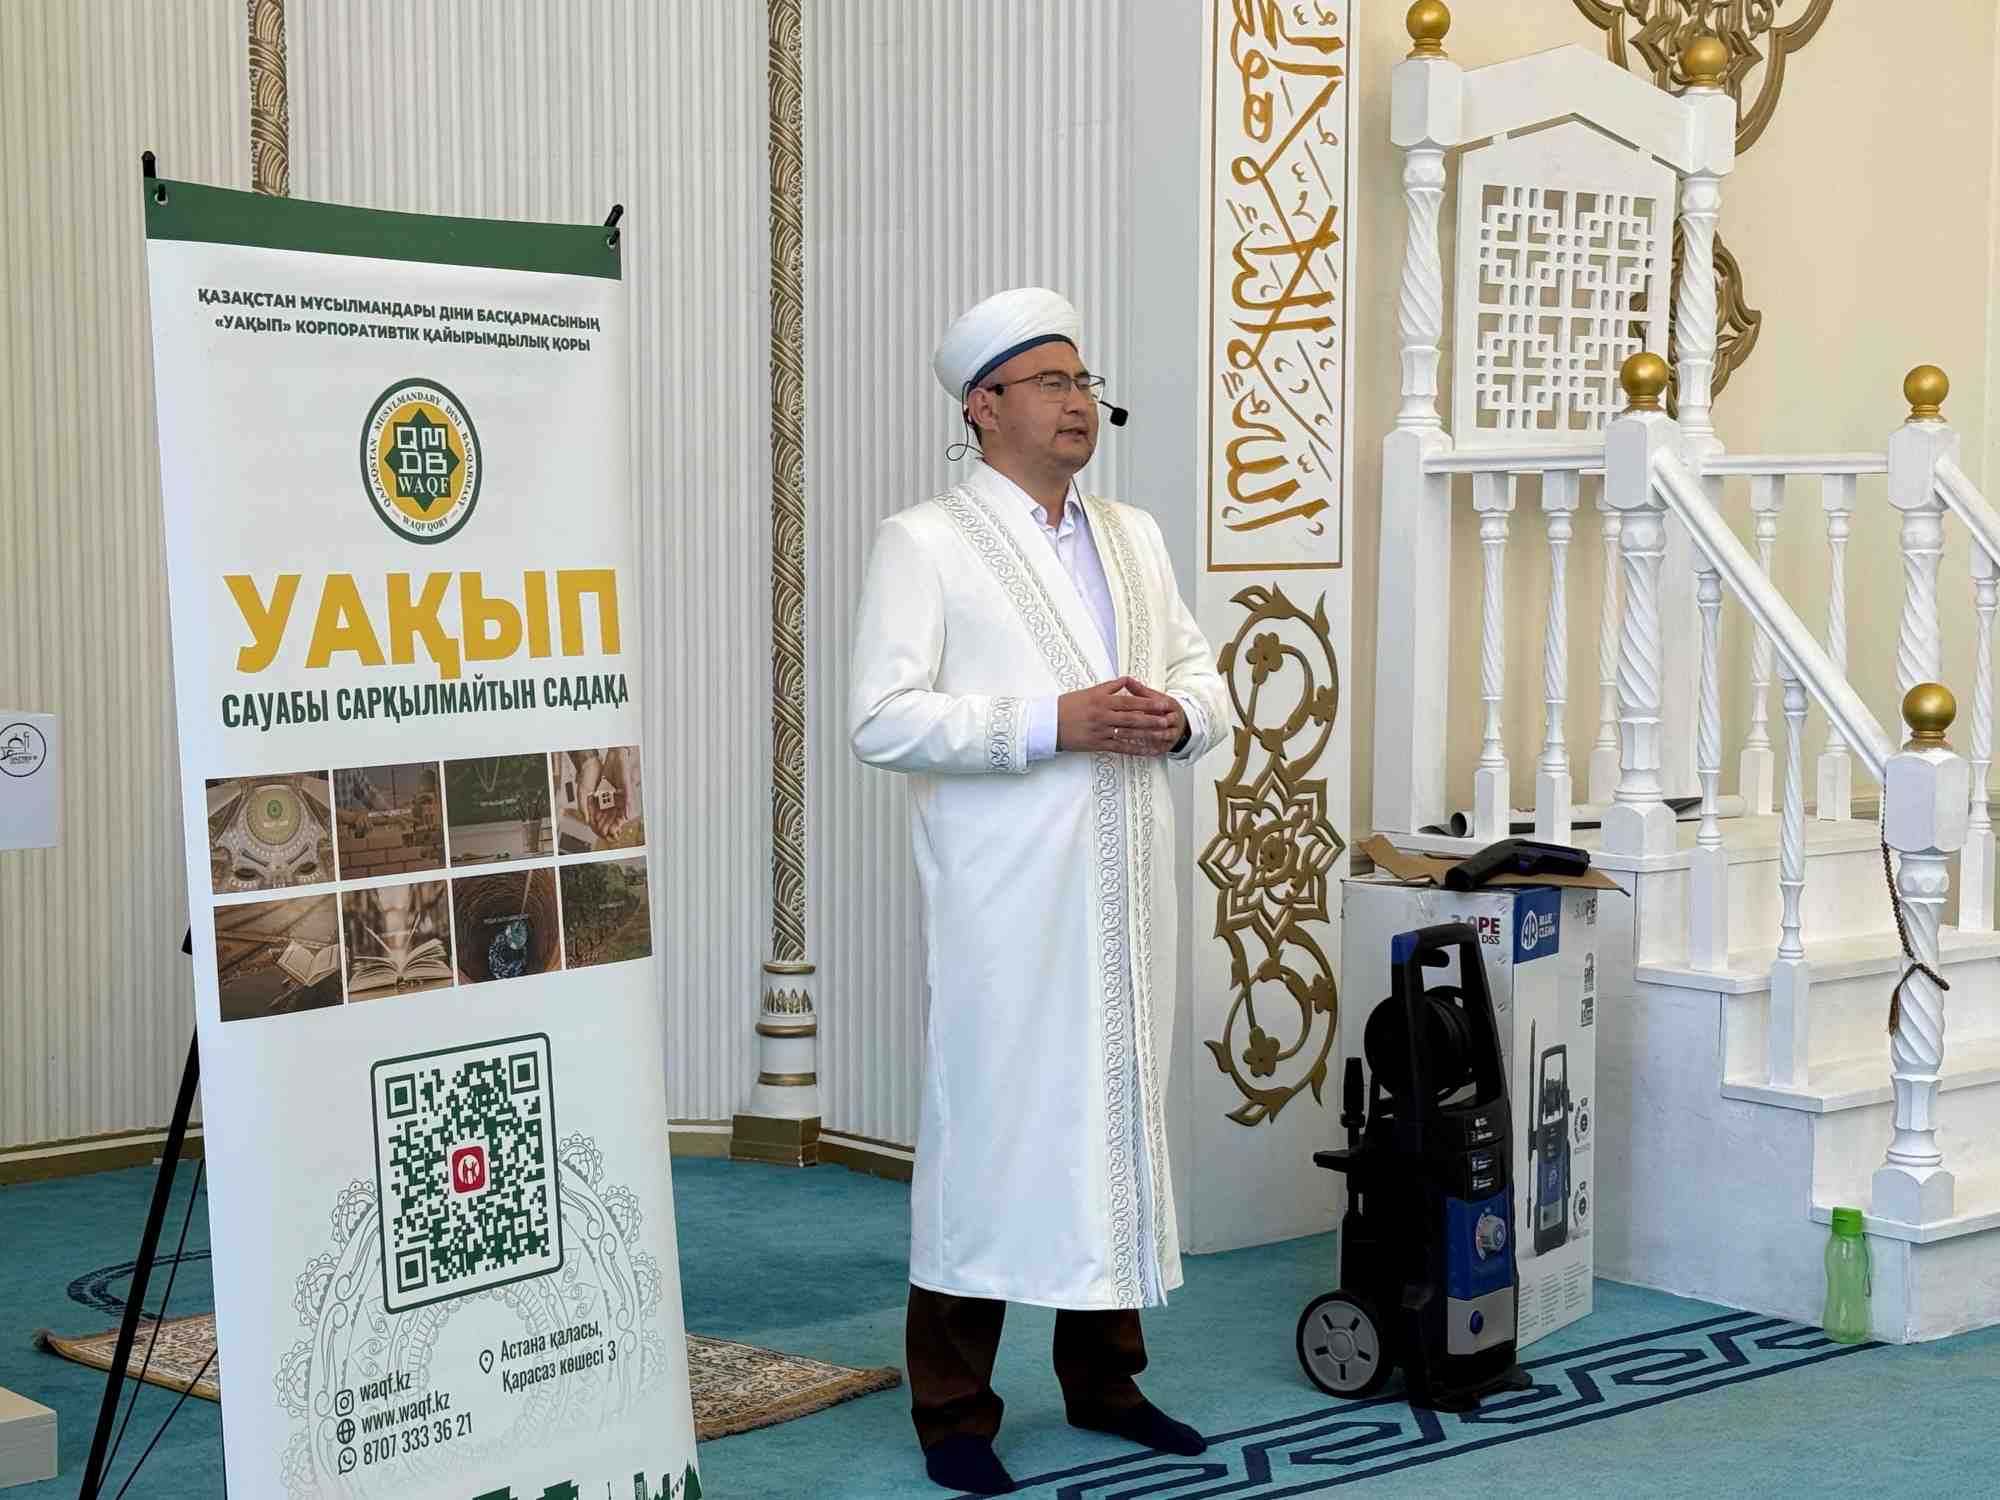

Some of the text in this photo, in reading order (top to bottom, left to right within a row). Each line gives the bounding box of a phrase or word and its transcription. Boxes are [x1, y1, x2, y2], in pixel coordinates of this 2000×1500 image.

[198, 288, 601, 332] ҚАЗАҚСТАН МҰСЫЛМАНДАРЫ ДІНИ БАСҚАРМАСЫНЫҢ
[215, 315, 590, 351] «УАҚЫП» КОРПОРАТИВТІК ҚАЙЫРЫМДЫЛЫҚ ҚОРЫ
[398, 476, 449, 496] WAQF
[223, 569, 621, 680] УАҚЫП
[222, 673, 629, 732] САУАБЫ САРҚЫЛМАЙТЫН САДАҚА
[500, 1319, 603, 1363] Астана қаласы,
[359, 1371, 412, 1403] waqf.kz
[502, 1339, 617, 1395] Қарасаз көшесі 3
[361, 1390, 451, 1434] www.waqf.kz
[363, 1411, 473, 1465] 8707 333 36 21
